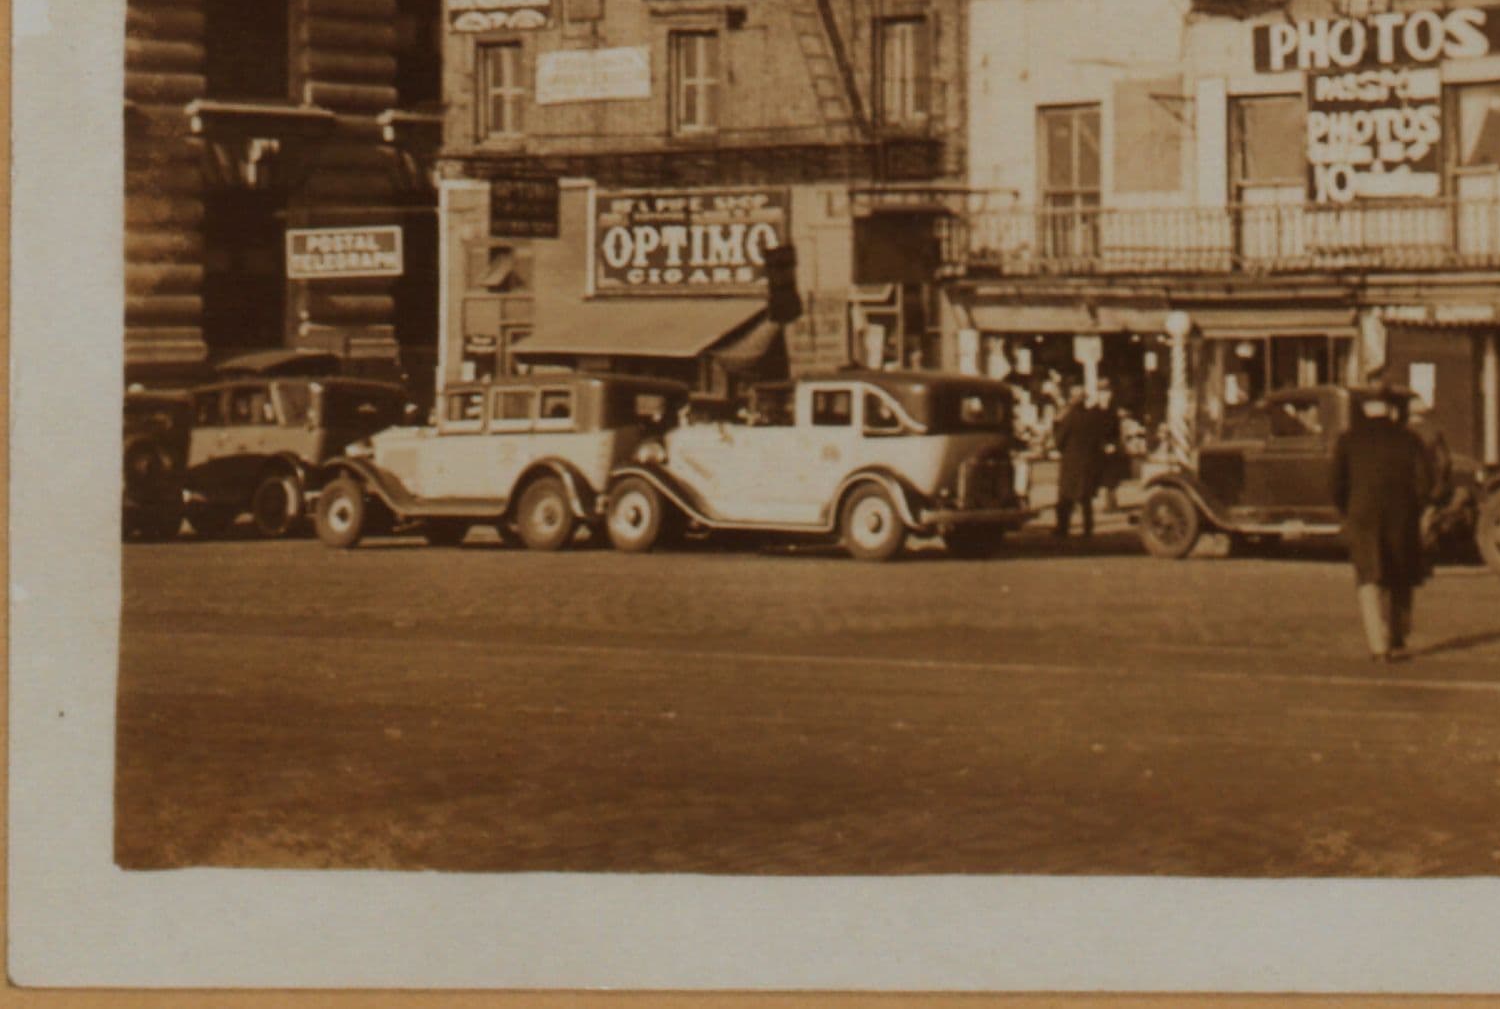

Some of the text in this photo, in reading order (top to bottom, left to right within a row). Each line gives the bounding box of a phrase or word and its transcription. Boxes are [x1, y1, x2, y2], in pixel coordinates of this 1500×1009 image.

[1267, 7, 1489, 72] PHOTOS
[1308, 104, 1442, 146] PHOTOS
[626, 267, 754, 284] CIGARS
